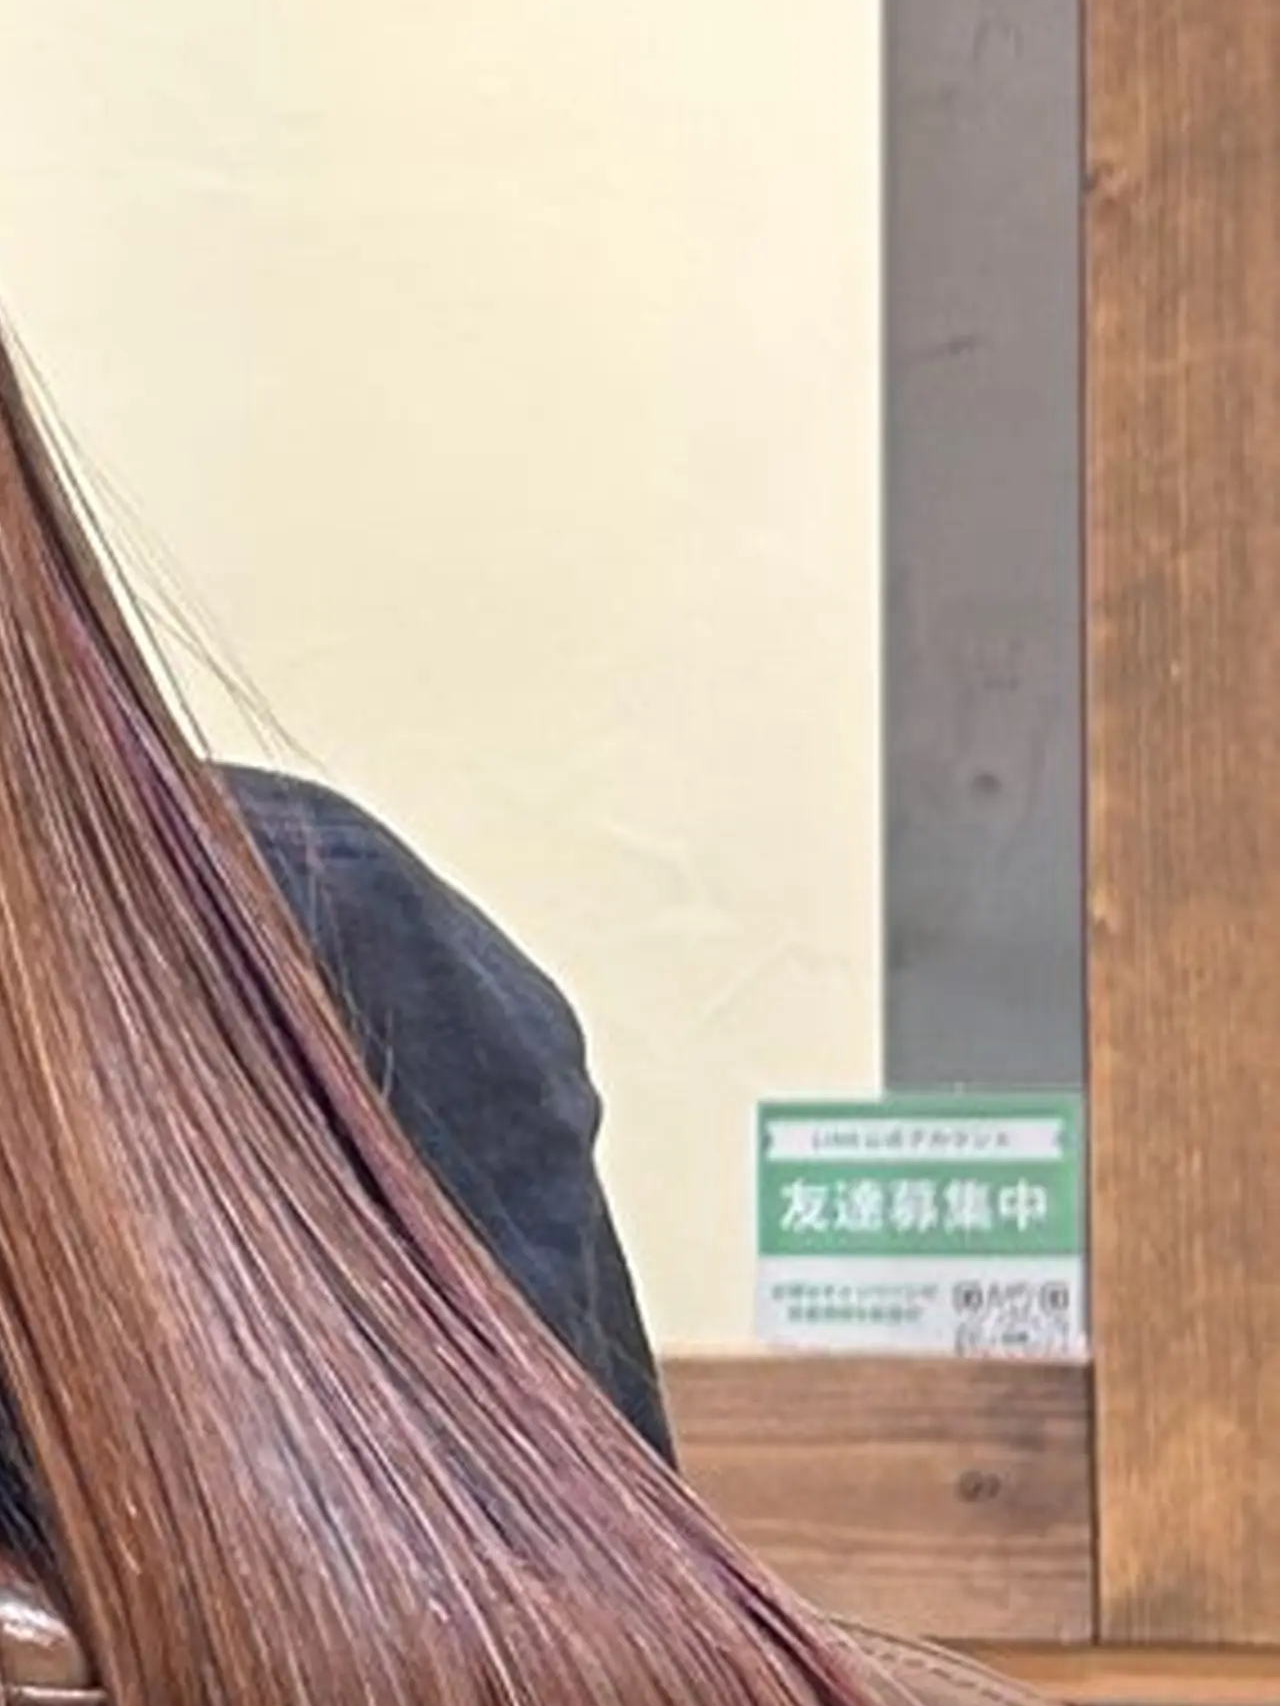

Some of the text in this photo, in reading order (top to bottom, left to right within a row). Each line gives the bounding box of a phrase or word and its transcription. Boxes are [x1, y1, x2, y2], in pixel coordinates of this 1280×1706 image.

[780, 1177, 1048, 1233] 友達募集中
